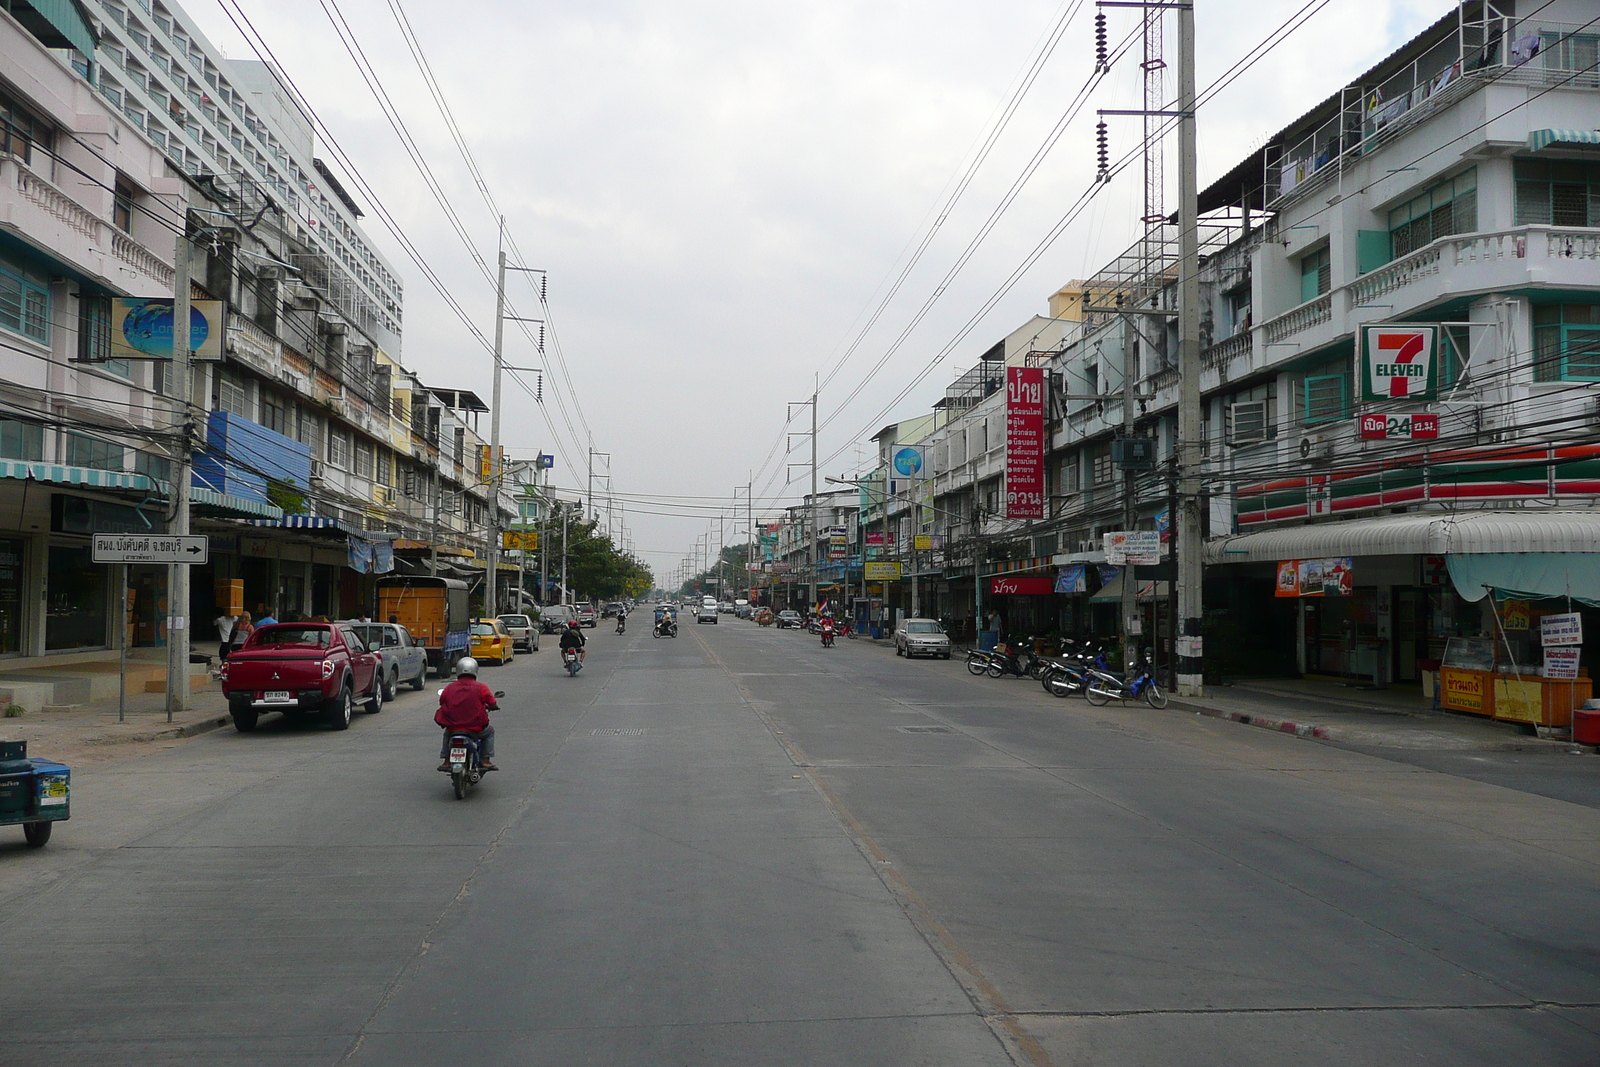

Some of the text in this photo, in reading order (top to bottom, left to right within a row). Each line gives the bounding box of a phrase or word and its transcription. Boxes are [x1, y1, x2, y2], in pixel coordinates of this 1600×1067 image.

[1378, 334, 1424, 396] 7
[1009, 368, 1041, 403] ป้าย
[1363, 417, 1385, 431] เปิด
[1387, 417, 1410, 436] 24
[1008, 486, 1041, 505] ด่วน
[1448, 673, 1479, 692] ข้าวแกง
